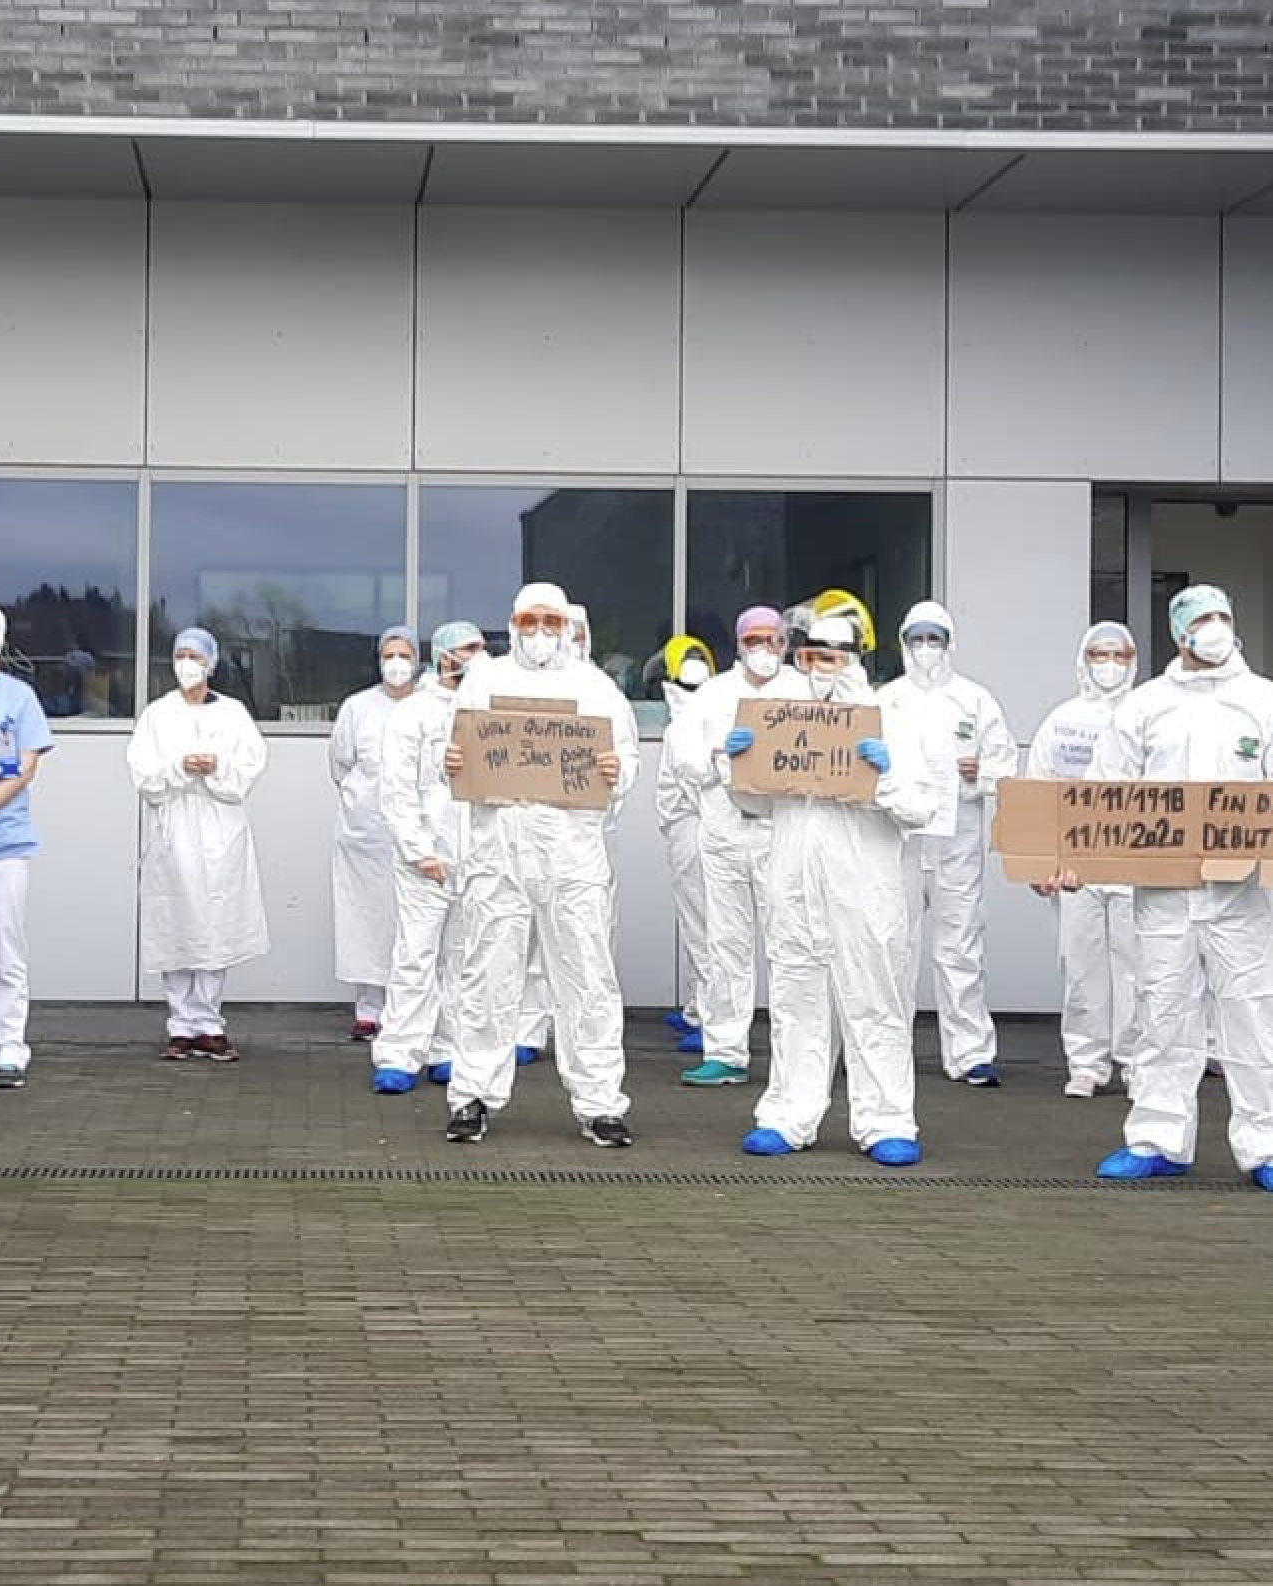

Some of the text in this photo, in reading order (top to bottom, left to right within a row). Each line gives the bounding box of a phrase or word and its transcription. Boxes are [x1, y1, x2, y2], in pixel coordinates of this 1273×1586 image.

[773, 751, 824, 772] BOUT
[1208, 787, 1246, 814] FIN
[1064, 818, 1185, 849] 11/11/2020
